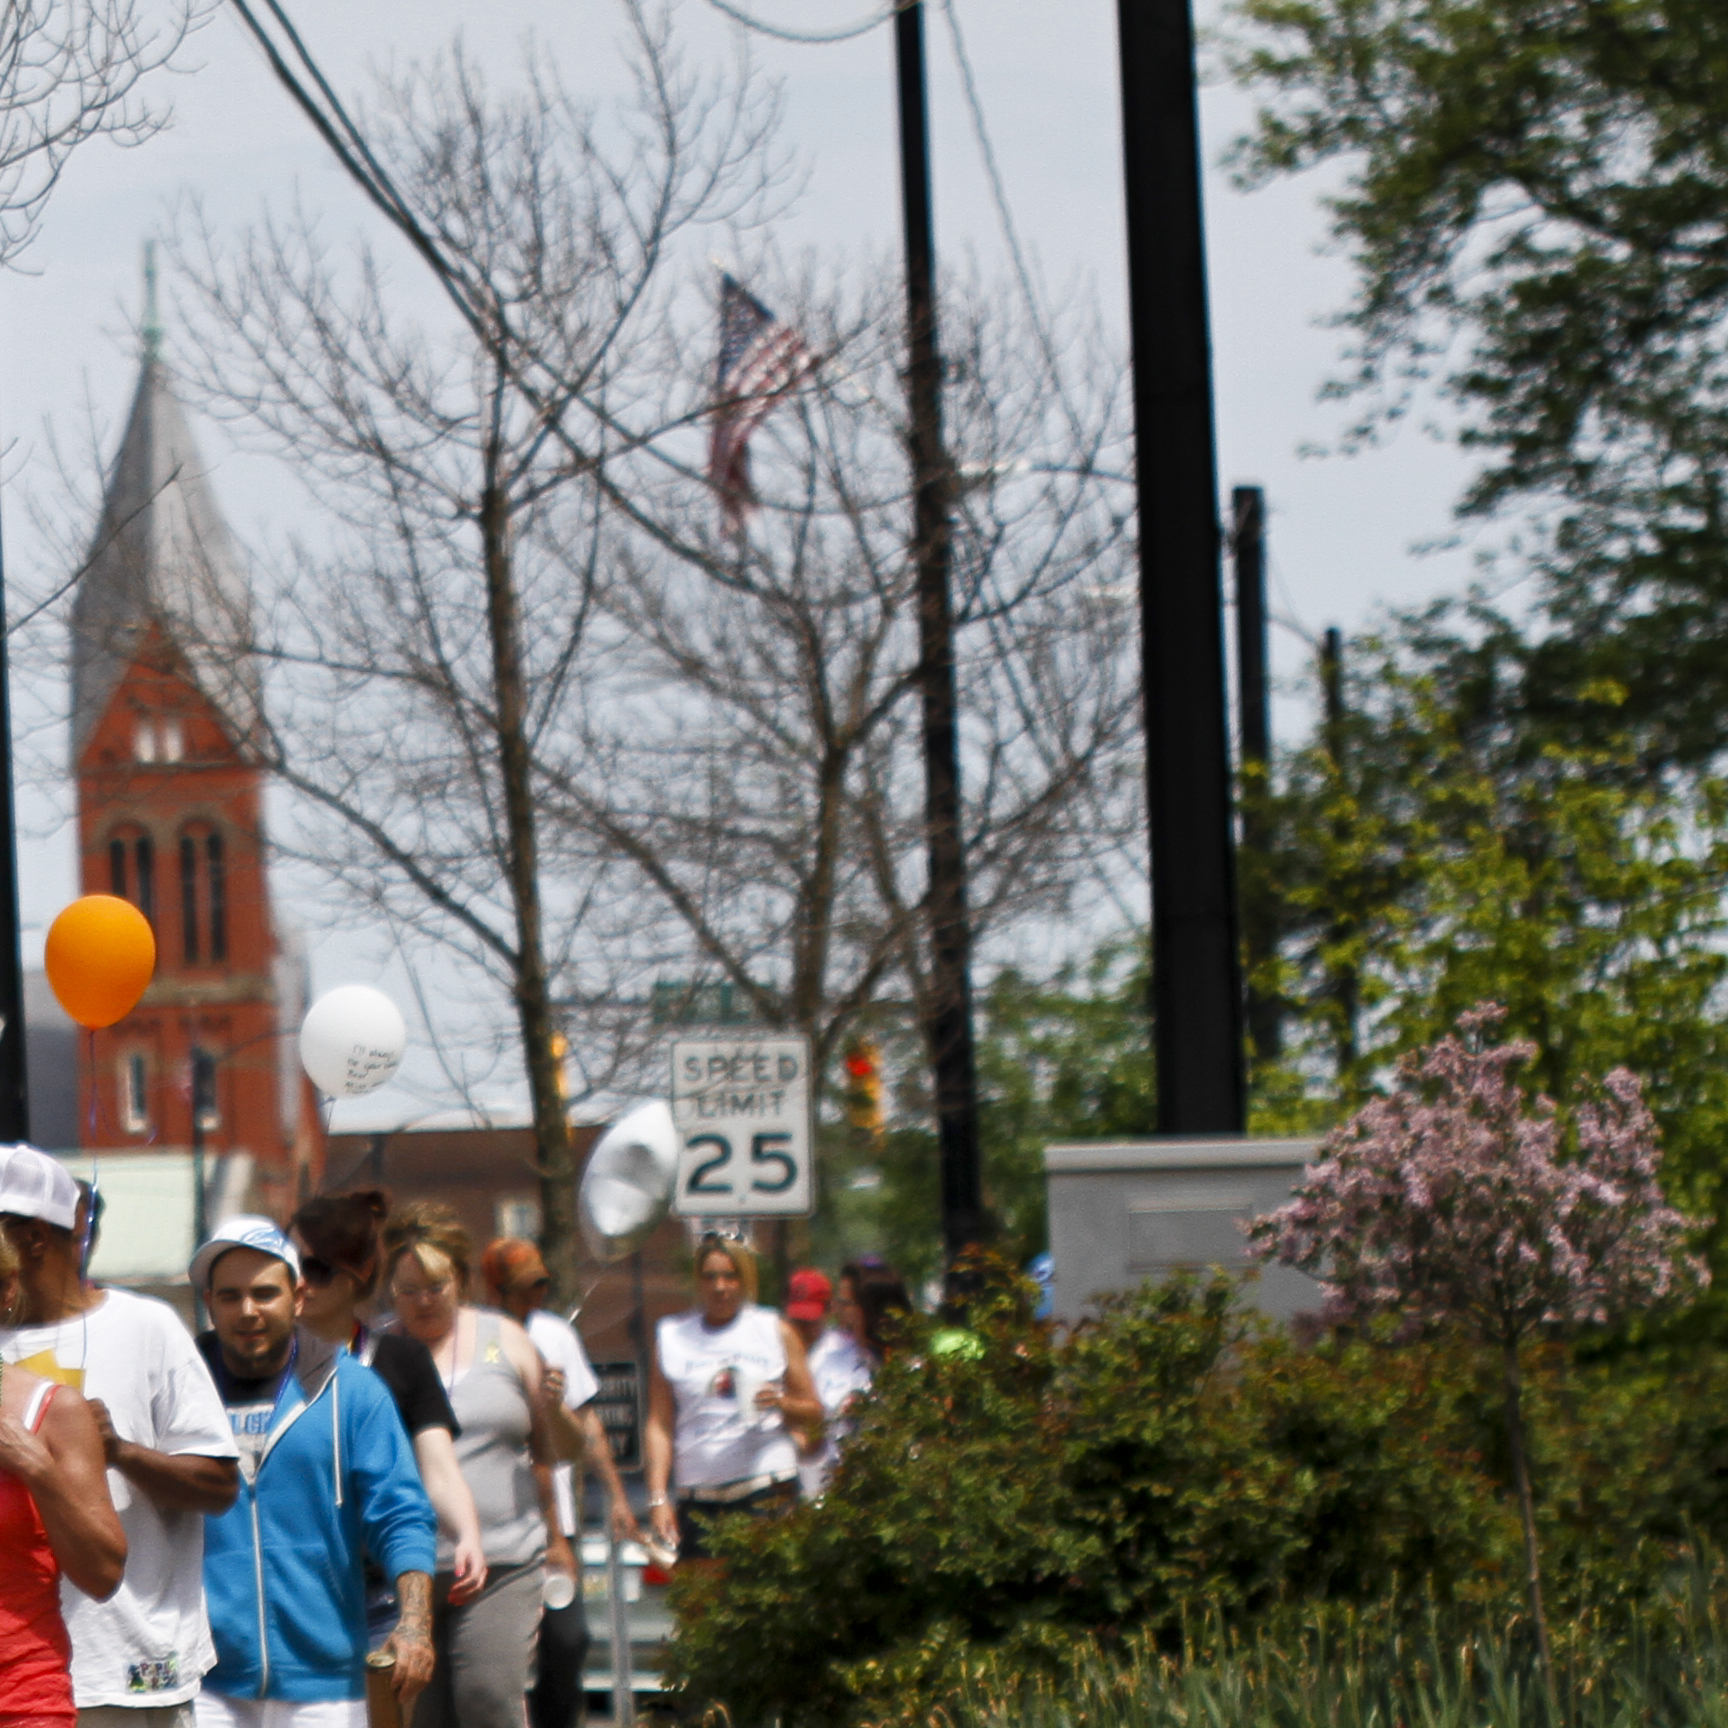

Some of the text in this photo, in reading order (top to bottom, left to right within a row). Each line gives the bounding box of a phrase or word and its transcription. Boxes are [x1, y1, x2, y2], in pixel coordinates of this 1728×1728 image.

[684, 1053, 799, 1082] SPEED
[697, 1089, 785, 1117] LIMIT
[686, 1132, 799, 1194] 25
